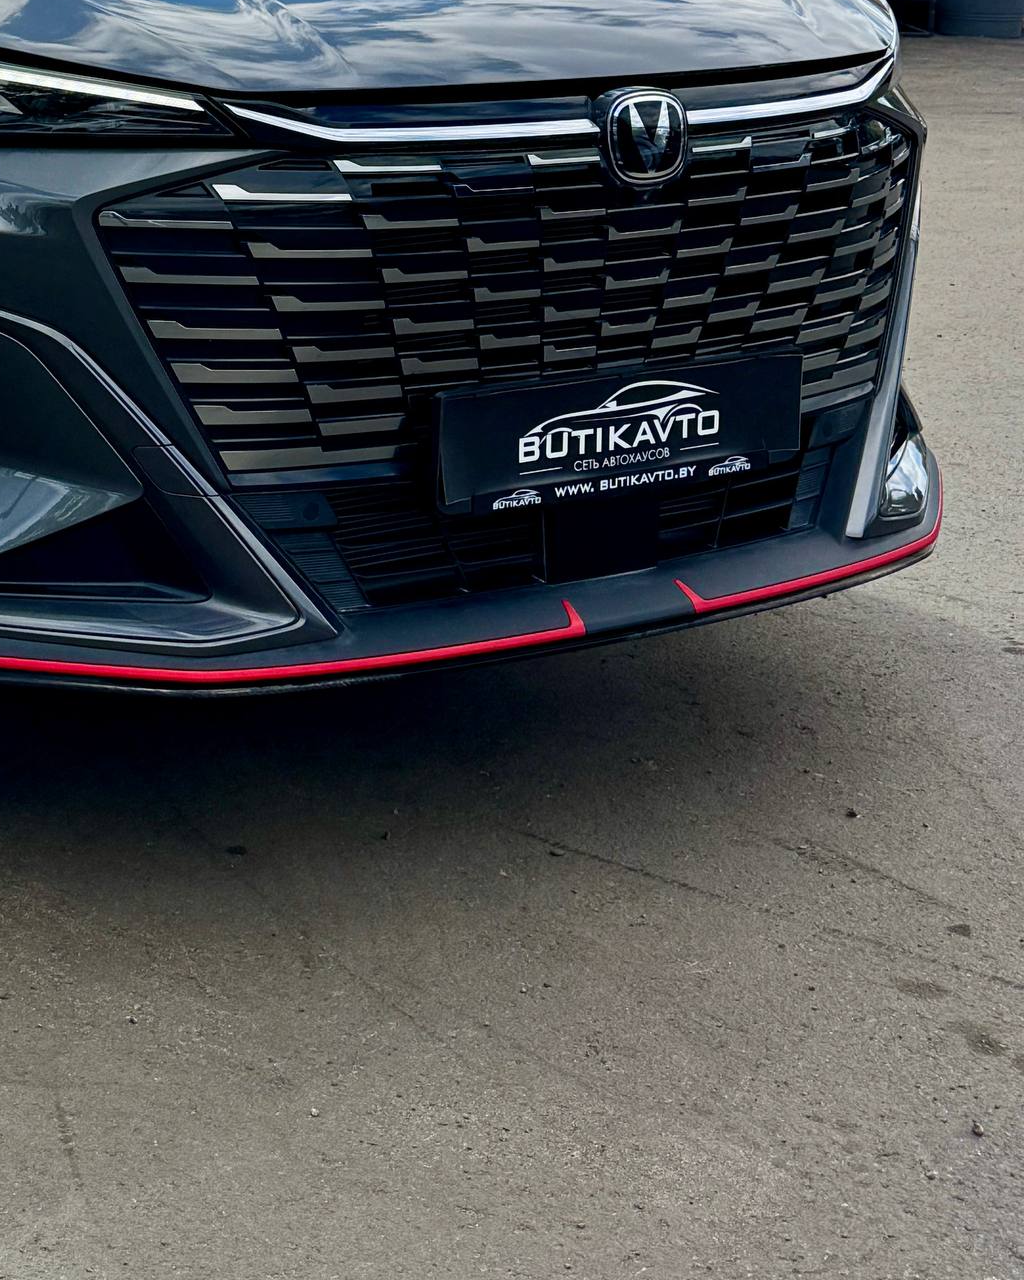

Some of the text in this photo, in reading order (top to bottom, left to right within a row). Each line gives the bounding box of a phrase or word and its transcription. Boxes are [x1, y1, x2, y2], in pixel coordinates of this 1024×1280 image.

[518, 410, 720, 464] BUTIKAVTO
[573, 447, 670, 472] СЕТЬ АВТОХАУСОВ
[708, 462, 751, 476] BUTIKAVTO
[555, 465, 697, 498] WWW. BUTIKAVTO.BY
[492, 497, 542, 510] BUTIKAVTO
